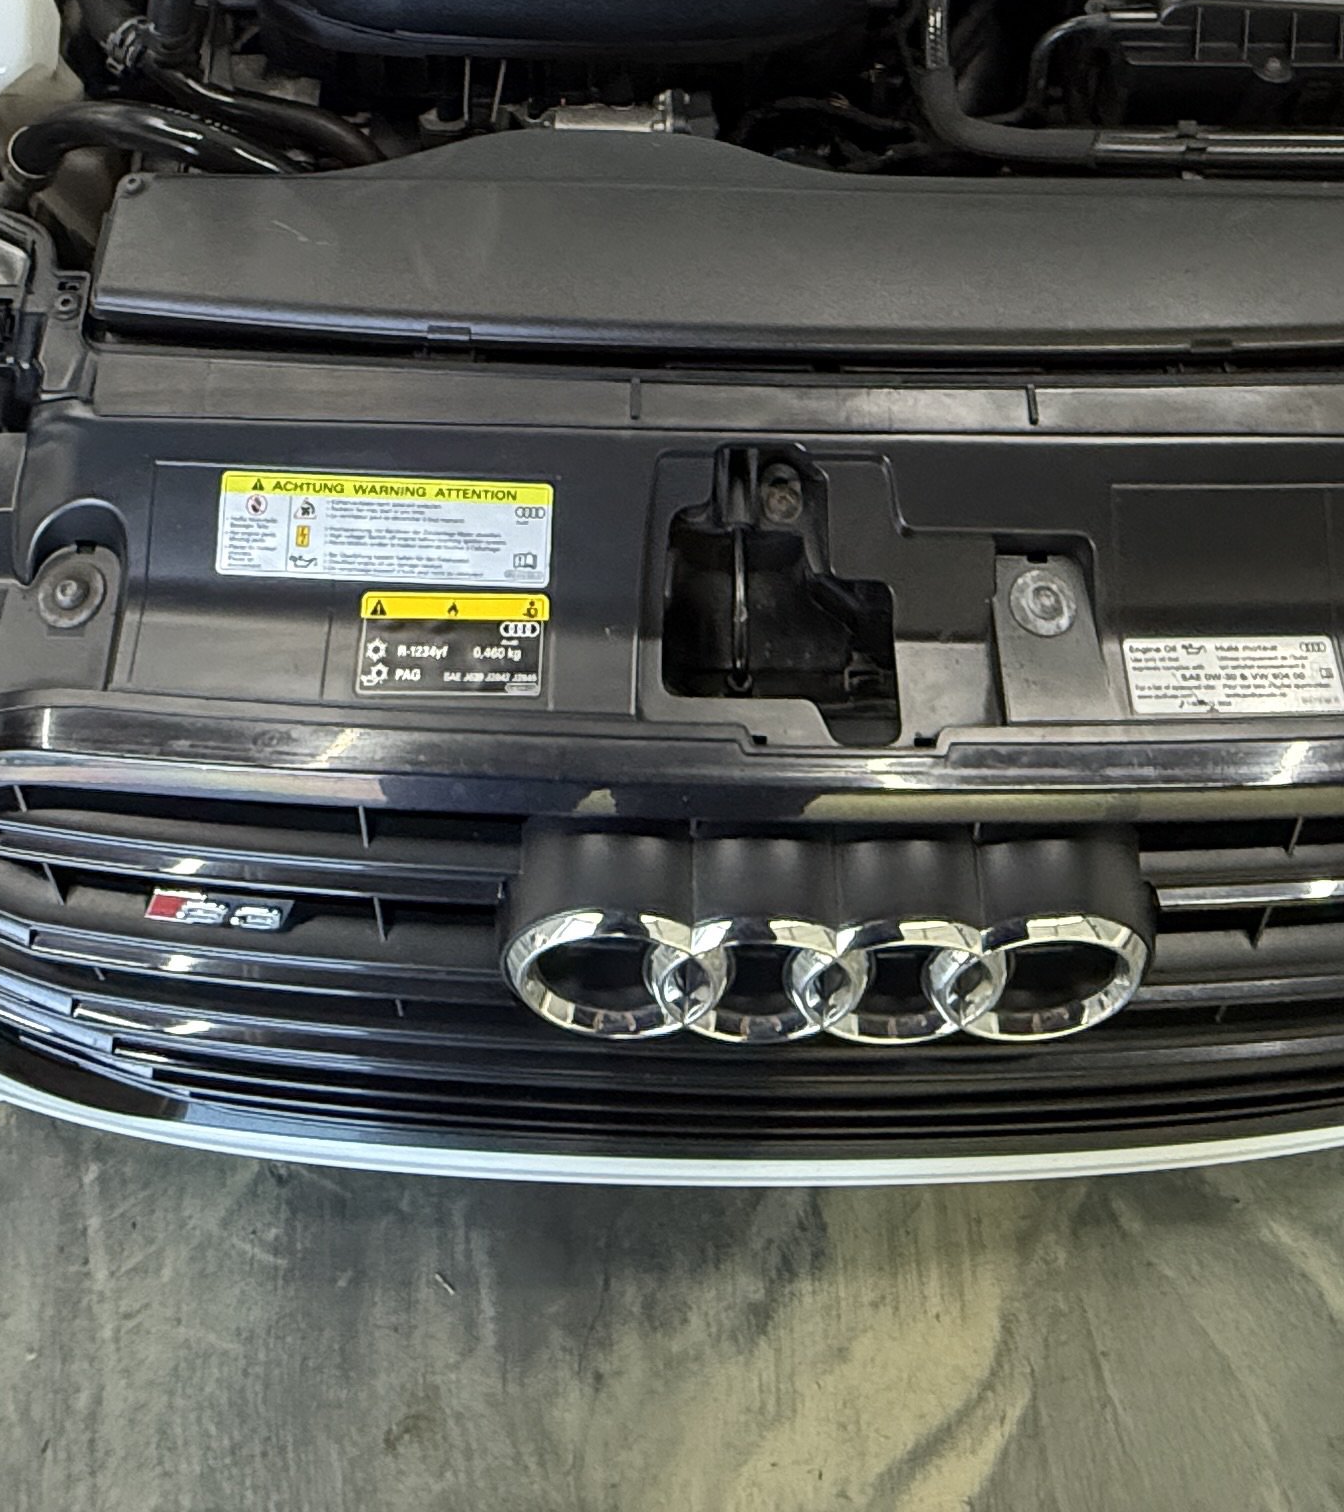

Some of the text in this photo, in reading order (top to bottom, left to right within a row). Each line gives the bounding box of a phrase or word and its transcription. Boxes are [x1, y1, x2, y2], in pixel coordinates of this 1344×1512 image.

[272, 480, 518, 502] ACHTUNG WARNING ATTENTION
[506, 646, 522, 662] kg
[1128, 645, 1162, 655] Engine
[394, 668, 421, 681] PAG
